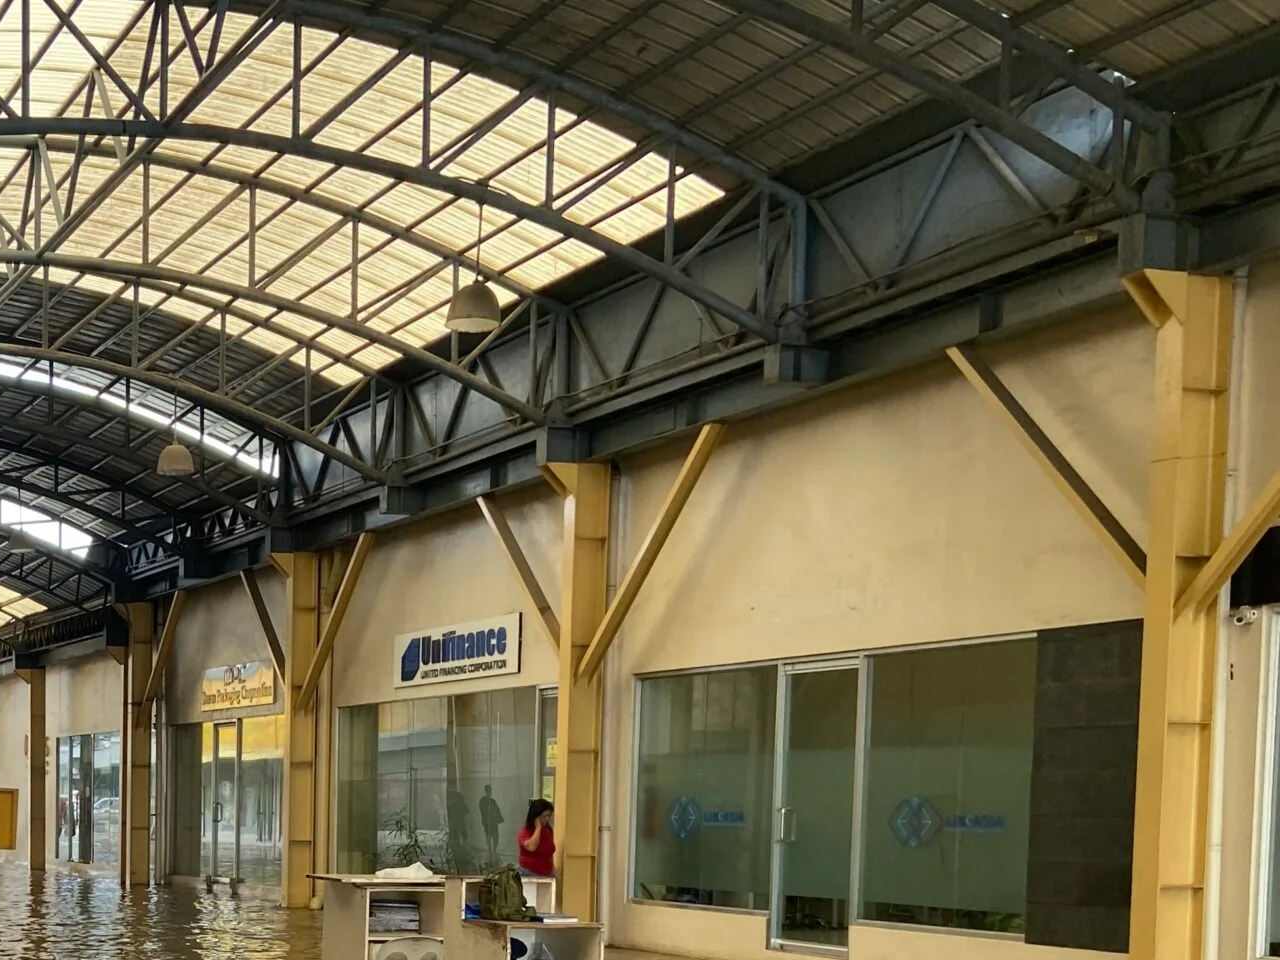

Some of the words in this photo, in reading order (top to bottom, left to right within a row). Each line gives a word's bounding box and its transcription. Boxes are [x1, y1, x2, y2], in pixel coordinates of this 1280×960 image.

[421, 627, 507, 665] Unifinance
[421, 668, 438, 679] UNITED
[439, 665, 467, 677] FINANCING
[467, 659, 507, 672] CORPORATION
